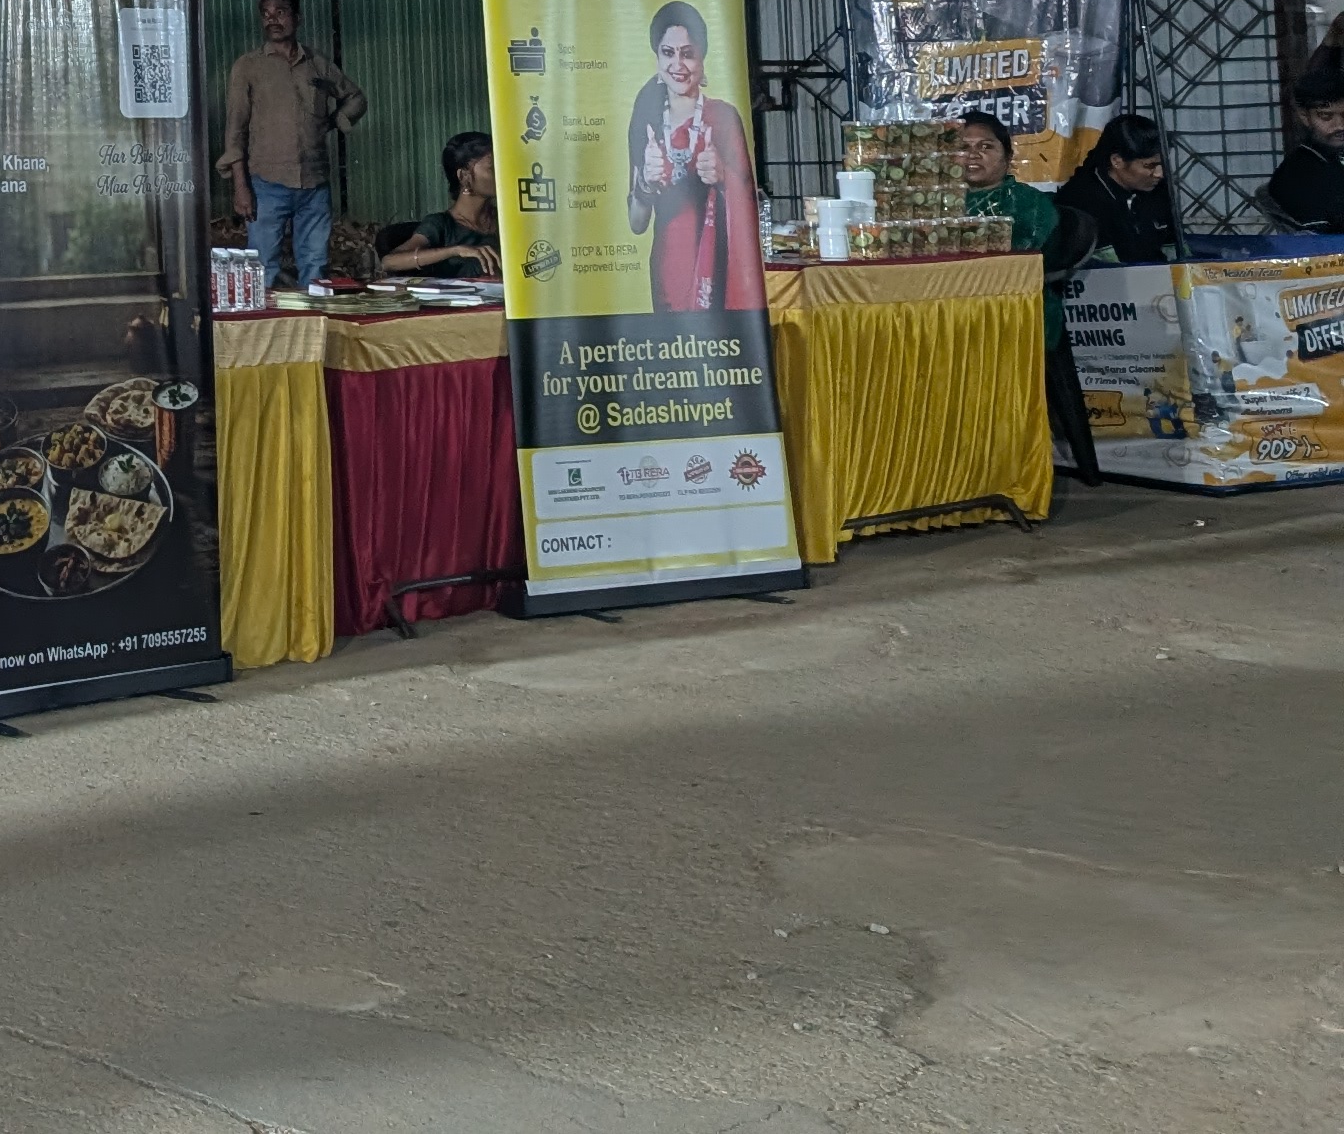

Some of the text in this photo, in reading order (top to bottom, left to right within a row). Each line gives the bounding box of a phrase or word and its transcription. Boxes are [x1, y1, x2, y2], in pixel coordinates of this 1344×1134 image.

[929, 49, 1030, 89] LIMITED
[584, 116, 606, 127] Loan
[2, 154, 50, 173] Khana,
[567, 182, 607, 194] Approved
[1065, 302, 1138, 323] THROOM
[1068, 328, 1126, 347] EANING
[560, 335, 741, 370] A perfect address
[543, 364, 763, 401] for your dream home
[577, 397, 734, 434] @ Sadashivpet
[541, 534, 604, 554] CONTACT
[0, 653, 25, 669] now
[28, 650, 44, 664] on
[46, 641, 109, 663] WhatsApp
[118, 635, 138, 652] +91
[141, 626, 208, 649] 7095557255
